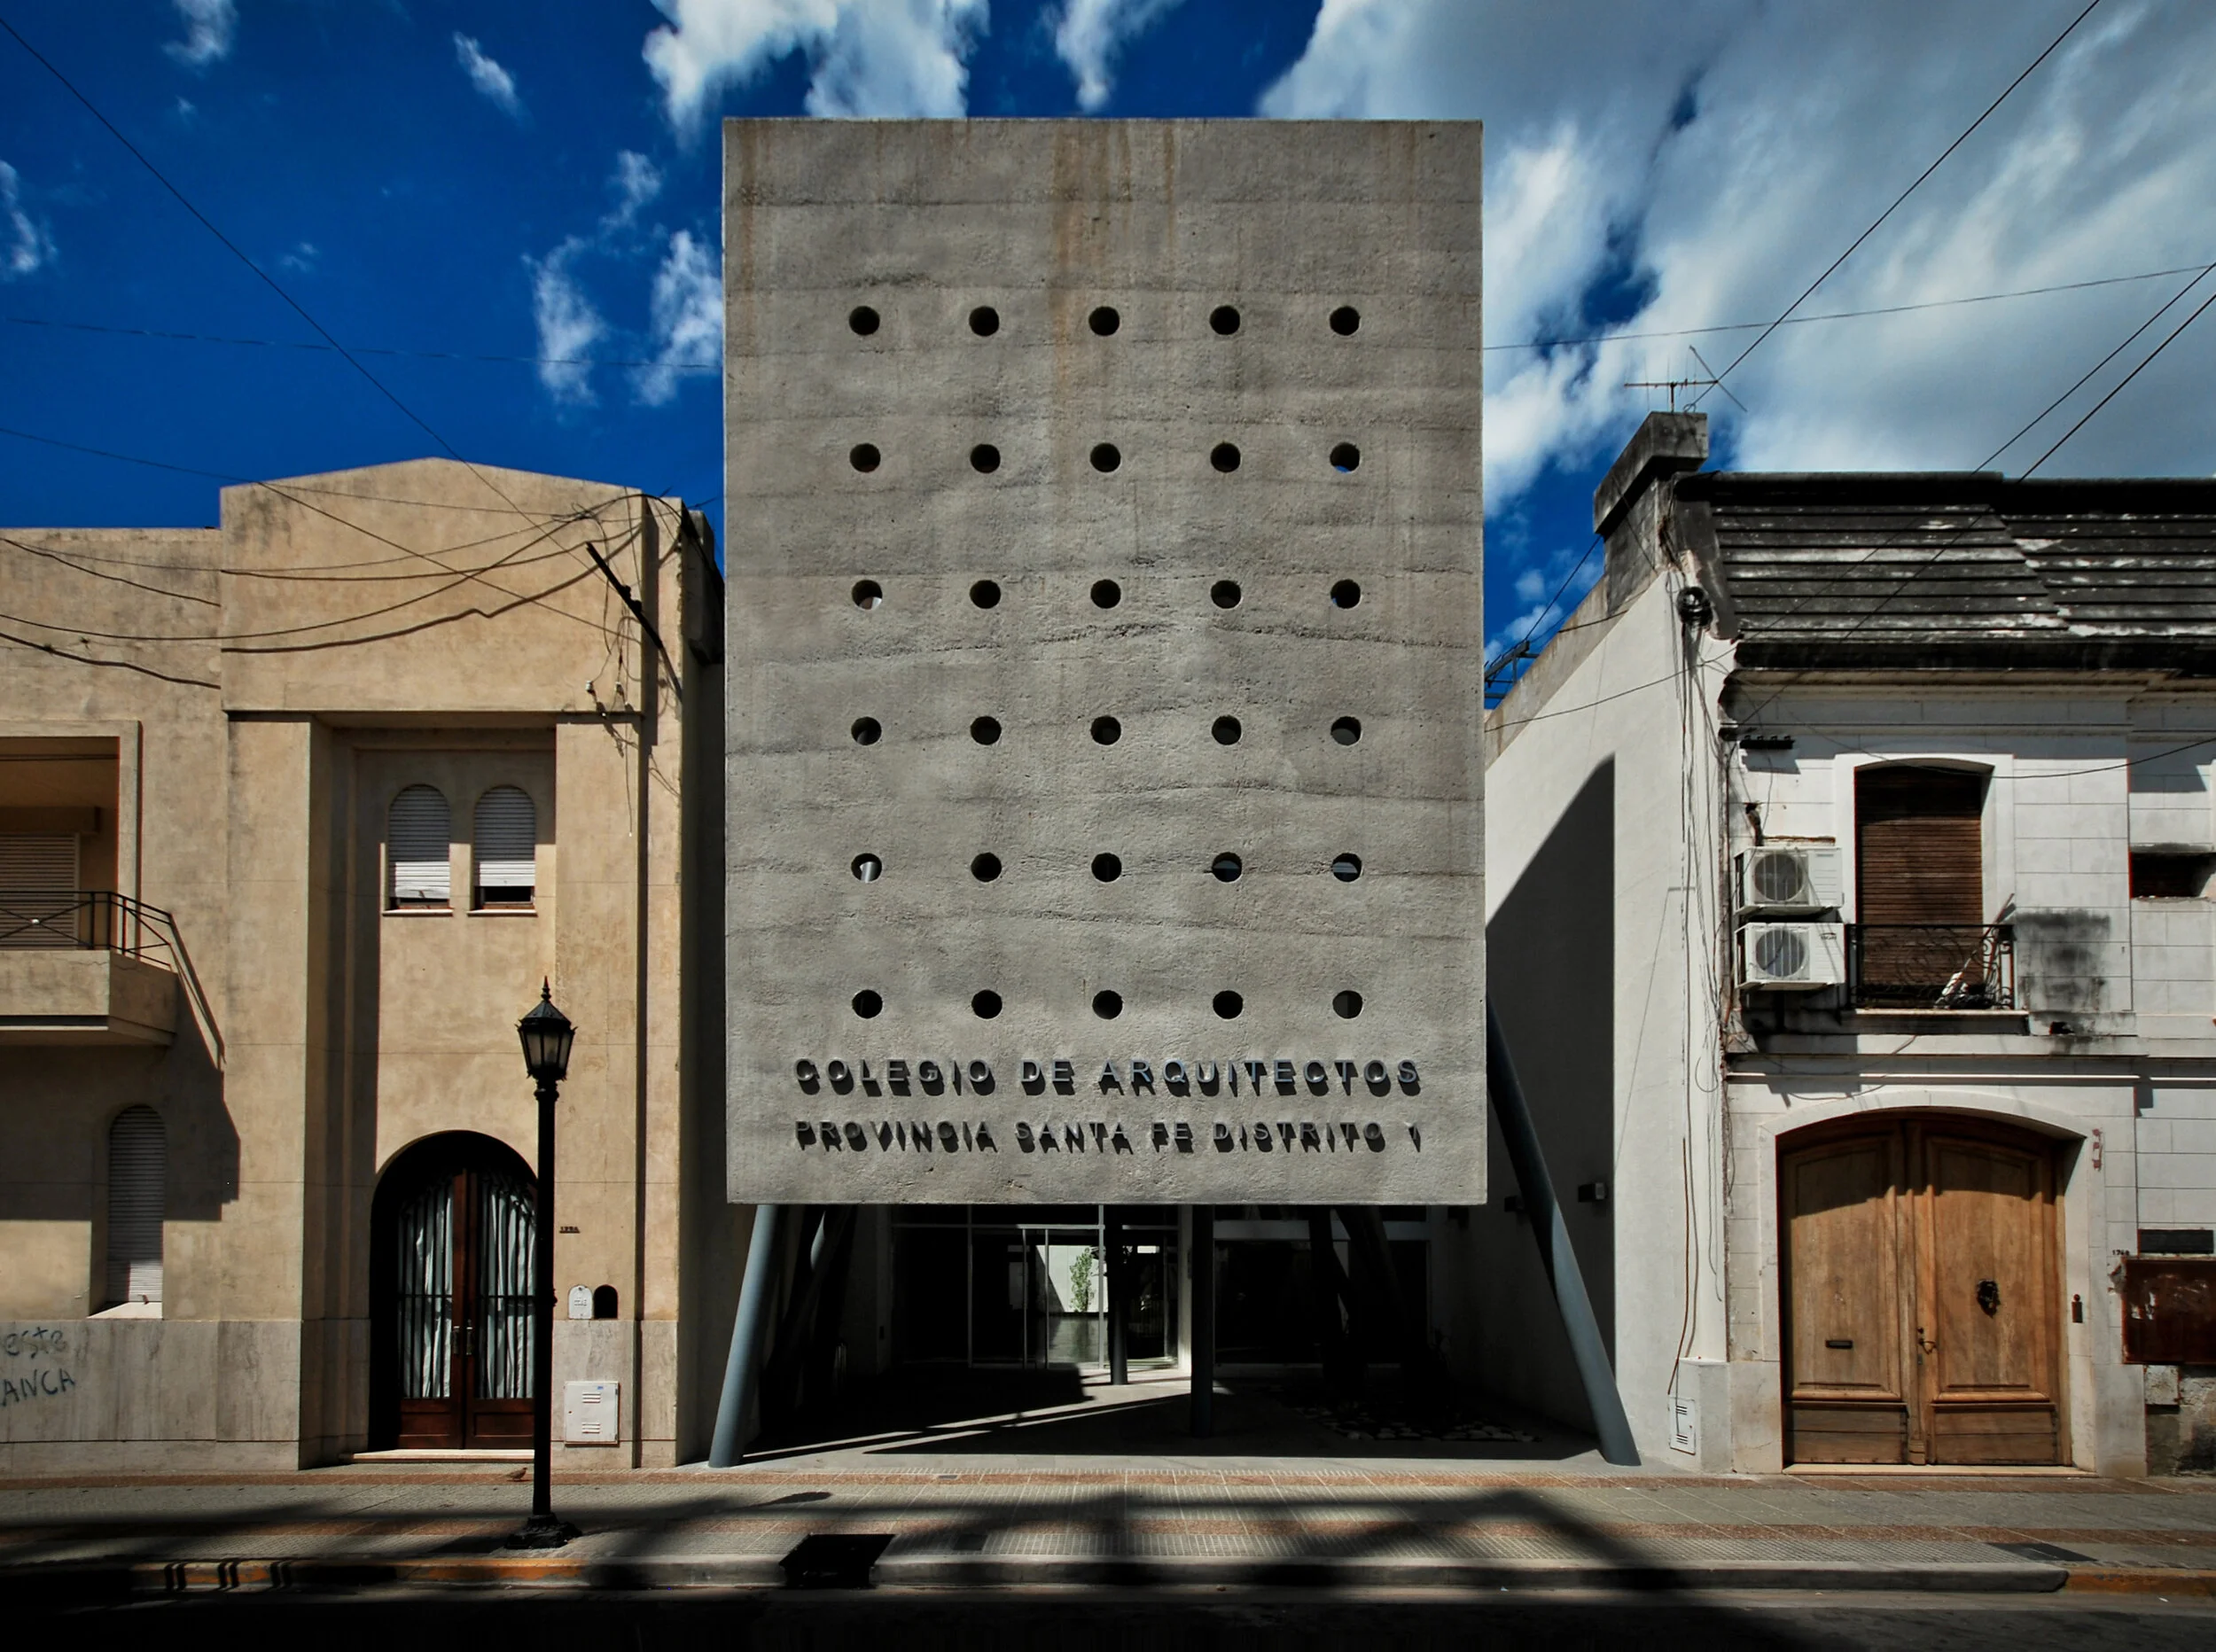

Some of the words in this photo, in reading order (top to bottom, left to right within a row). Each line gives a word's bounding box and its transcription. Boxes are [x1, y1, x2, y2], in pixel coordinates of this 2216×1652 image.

[795, 1059, 991, 1085] COLEGIO
[1020, 1059, 1073, 1085] DE
[1098, 1059, 1420, 1086] ARQUITECTOS
[795, 1120, 995, 1142] PROVINCIA
[1014, 1121, 1131, 1142] SANTA
[1151, 1122, 1191, 1143] FE
[1212, 1122, 1384, 1143] DISTRITO
